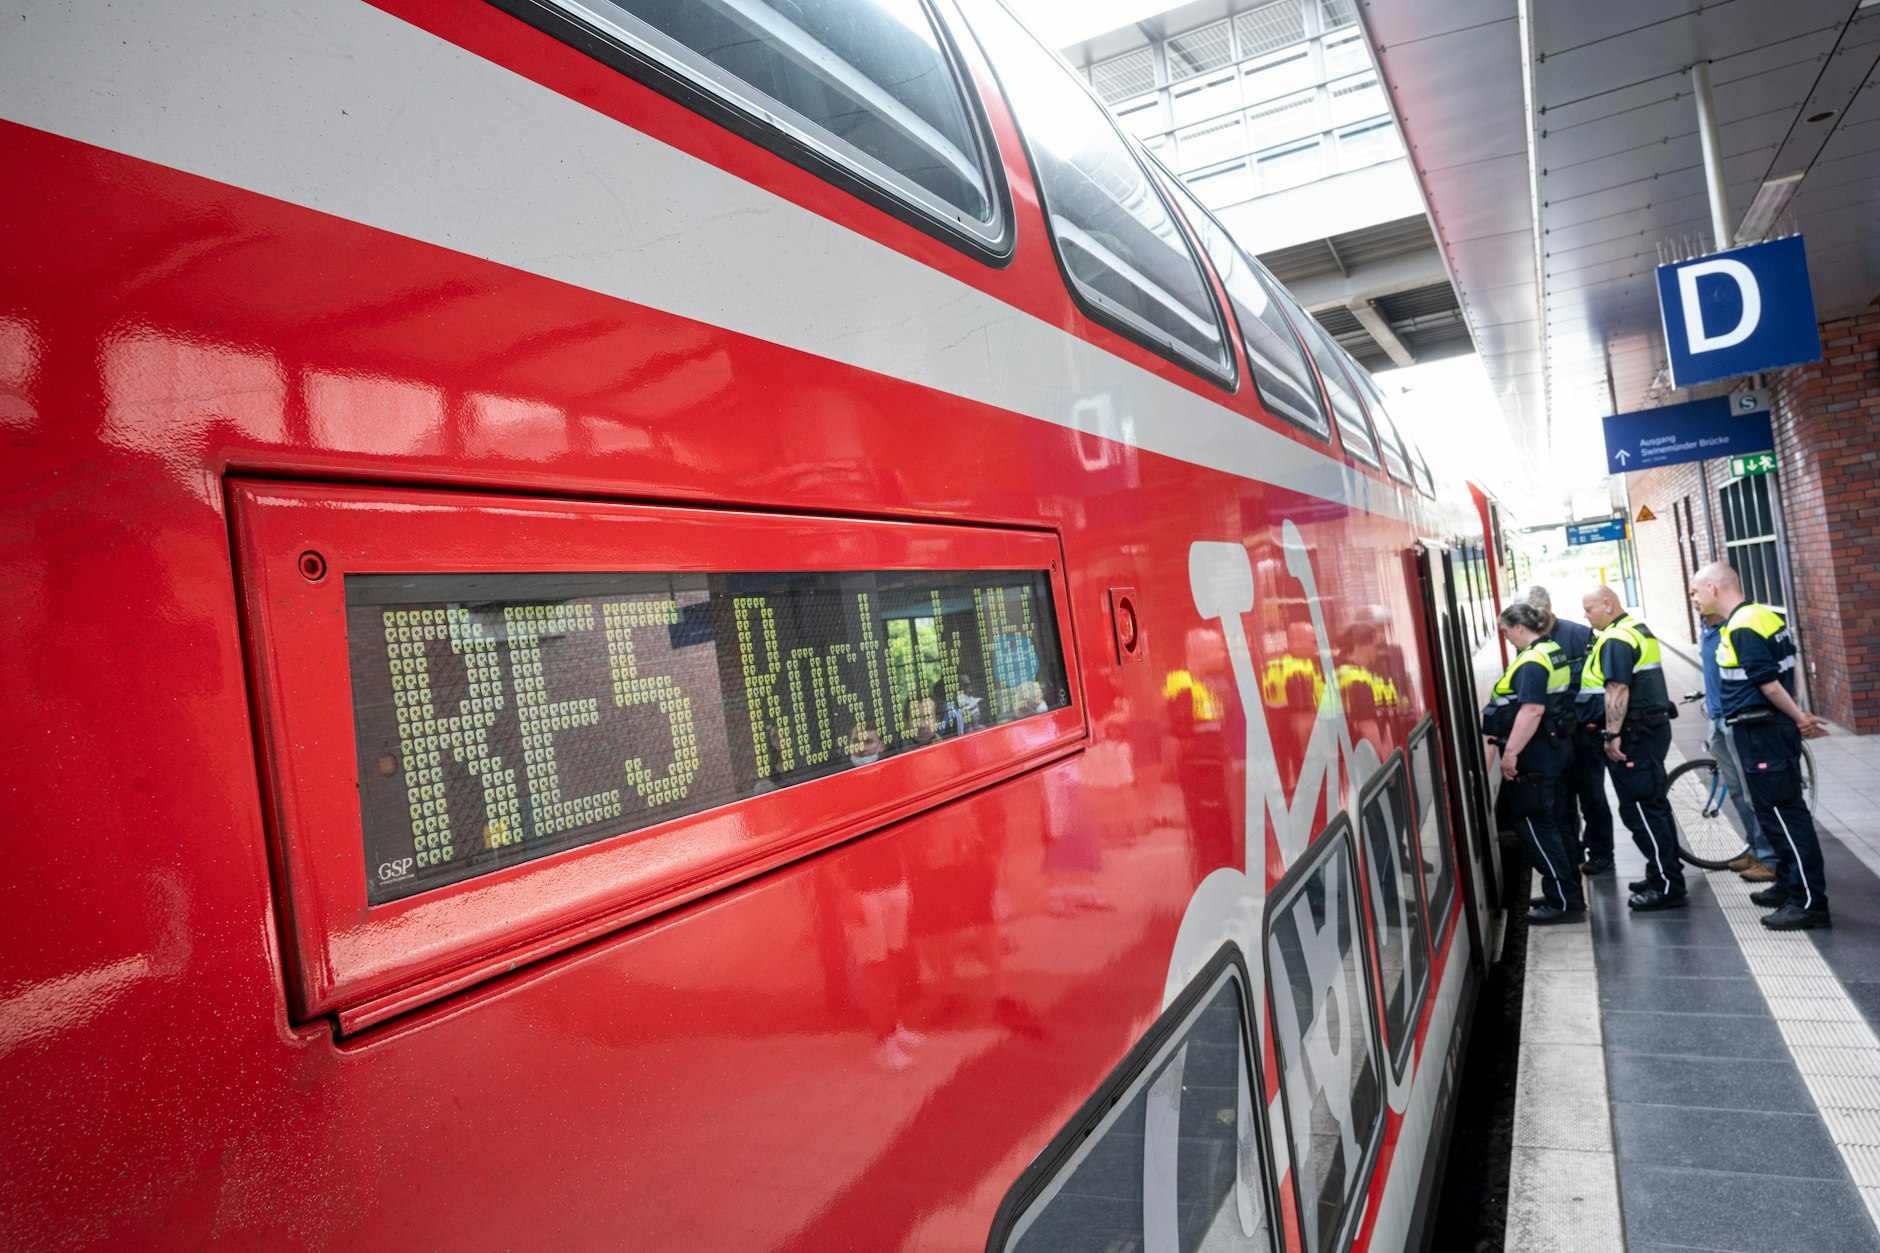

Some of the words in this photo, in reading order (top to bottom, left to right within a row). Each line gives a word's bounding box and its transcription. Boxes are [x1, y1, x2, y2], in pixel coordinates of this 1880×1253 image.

[1676, 258, 1762, 355] D
[1640, 435, 1676, 447] Ausgang
[1699, 436, 1730, 448] Brücke
[733, 589, 973, 779] Rostock
[378, 857, 413, 881] GSP
